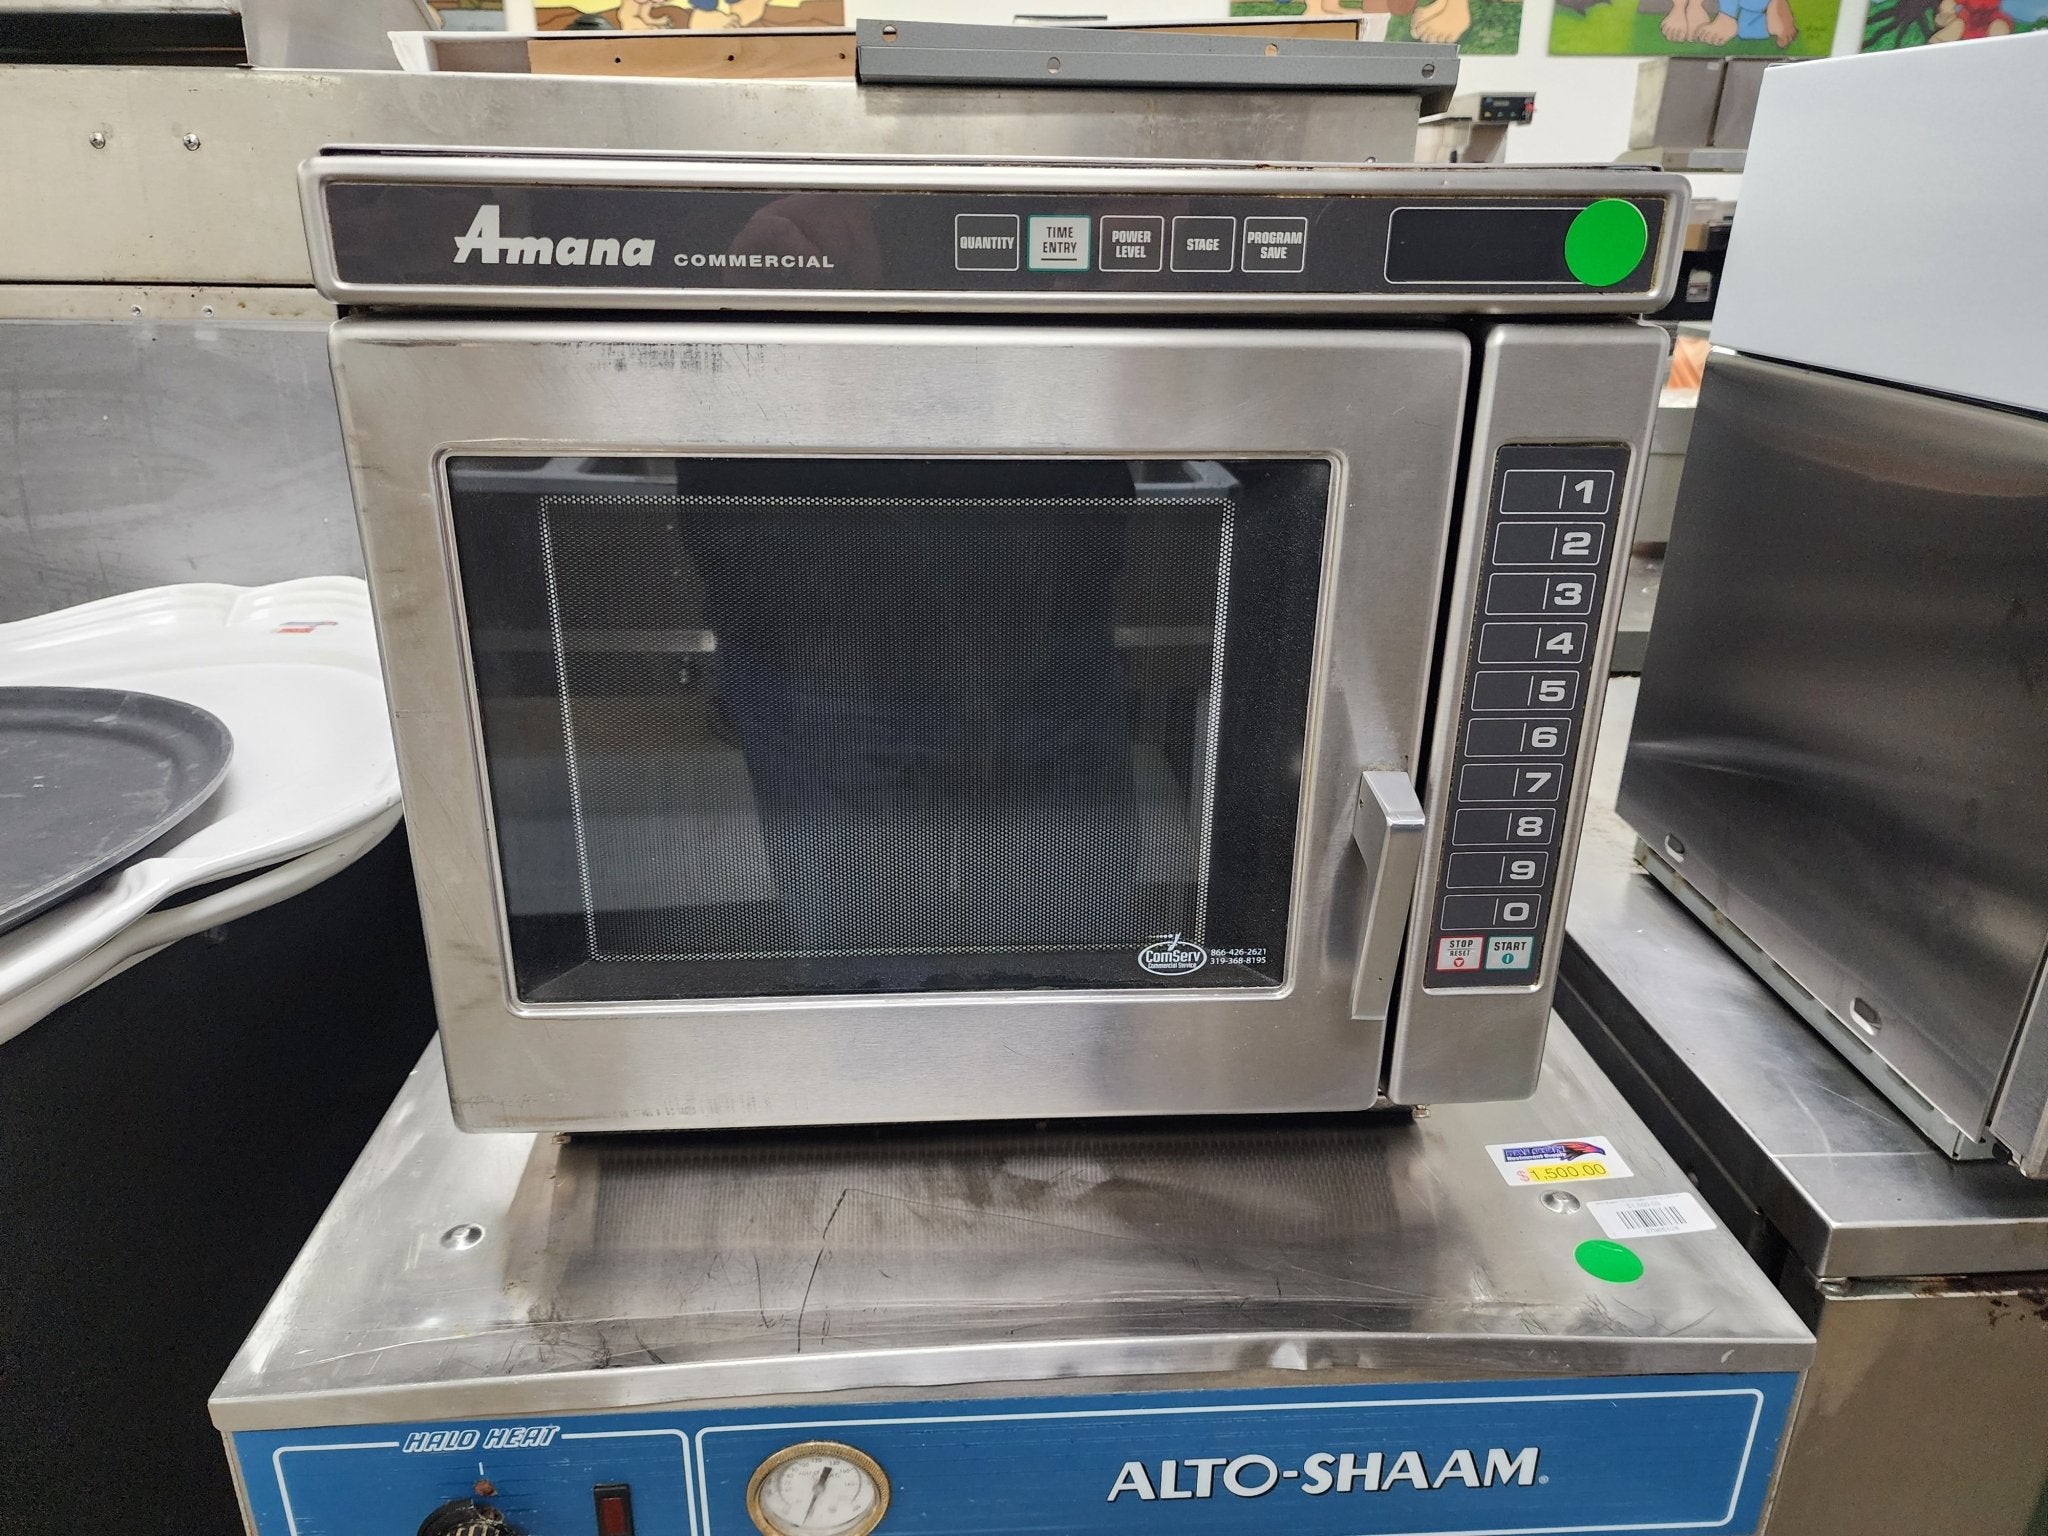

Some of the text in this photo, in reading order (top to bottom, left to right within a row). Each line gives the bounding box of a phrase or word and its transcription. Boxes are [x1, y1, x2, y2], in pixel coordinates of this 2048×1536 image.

[454, 204, 835, 269] Amana COMMERCIAL
[1046, 226, 1074, 239] TIME
[1111, 230, 1152, 244] POWER
[1247, 231, 1303, 245] PROGRAM
[960, 236, 1015, 250] QUANTITY
[1042, 241, 1078, 254] ENTRY
[1186, 238, 1220, 251] STAGE
[1115, 245, 1147, 259] LEVEL
[1260, 246, 1288, 259] SAVE
[1574, 480, 1595, 504] 1
[1561, 531, 1592, 556] 2
[1553, 582, 1583, 606] 3
[1545, 632, 1574, 655] 4
[1538, 680, 1567, 702] 5
[1531, 726, 1558, 748] 6
[1525, 772, 1552, 793] 7
[1516, 816, 1544, 837] 8
[1509, 860, 1536, 880] 9
[1503, 902, 1530, 922] 0
[1449, 940, 1474, 949] STOP
[1494, 941, 1527, 951] START
[1146, 949, 1201, 963] ComServ
[1210, 948, 1267, 956] 866-426-2621
[1210, 957, 1267, 965] 319-368-8195
[402, 1425, 561, 1453] HALO HEAT
